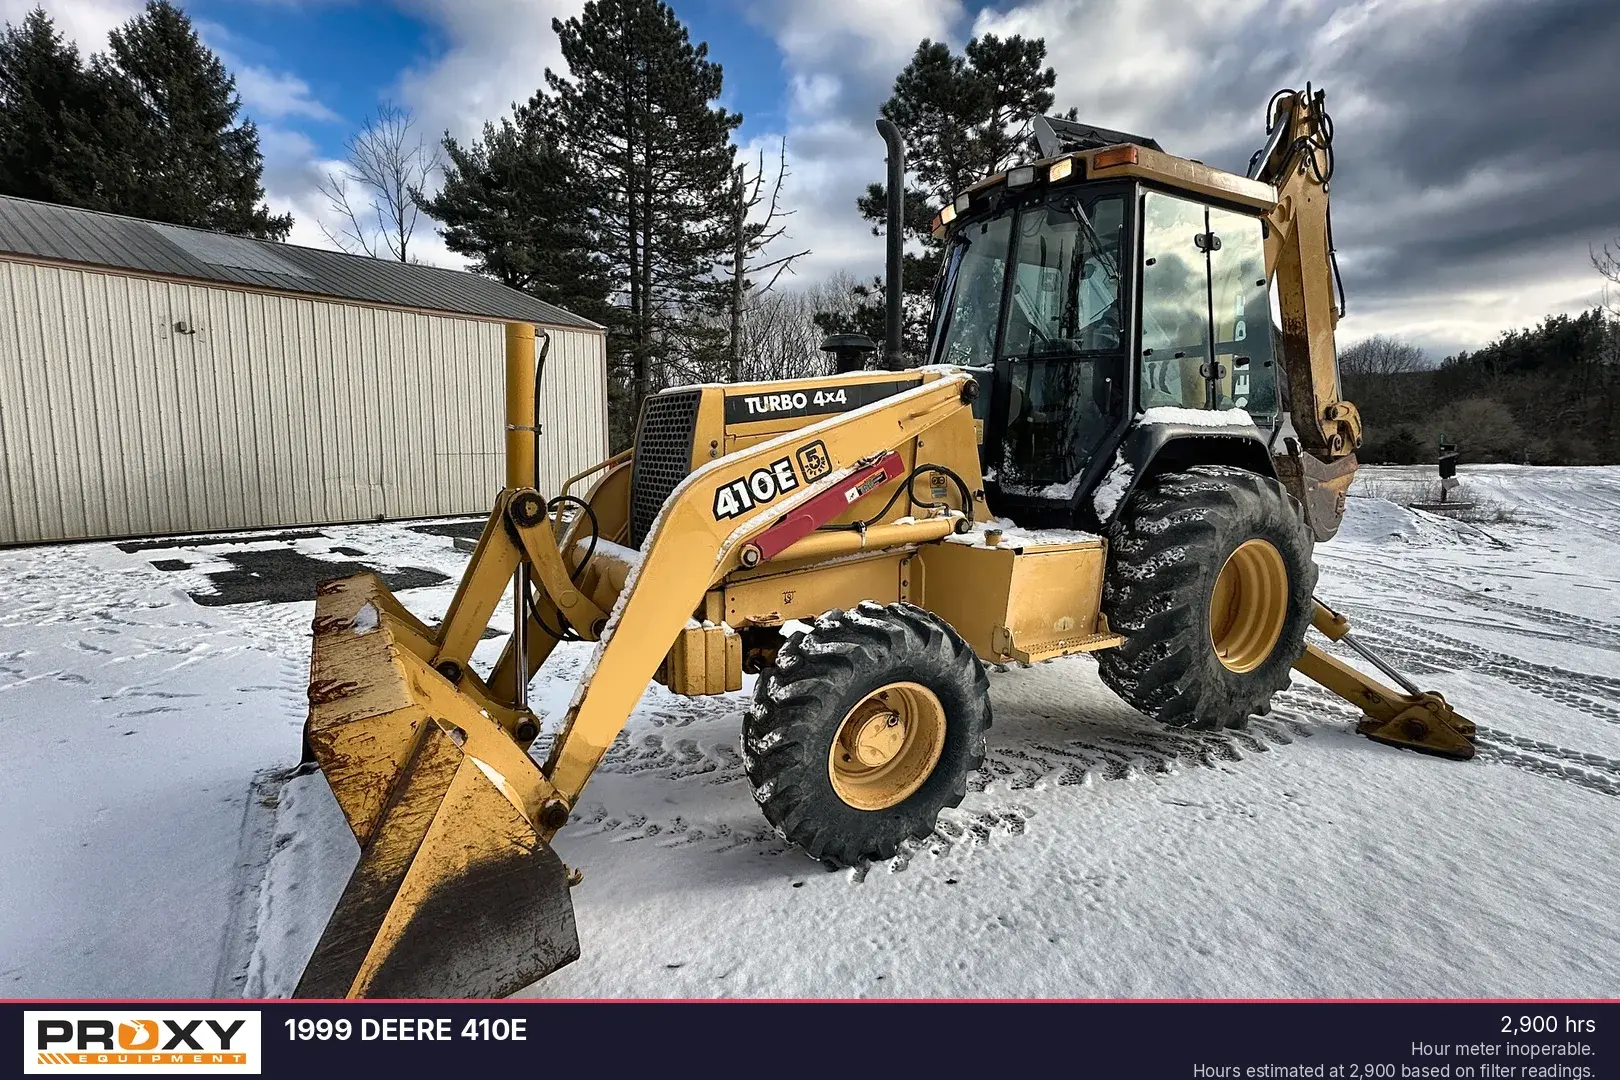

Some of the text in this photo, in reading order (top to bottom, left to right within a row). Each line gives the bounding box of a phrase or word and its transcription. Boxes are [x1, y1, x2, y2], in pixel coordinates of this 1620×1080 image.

[744, 389, 847, 414] TURBO 4x4
[714, 457, 798, 520] 410E
